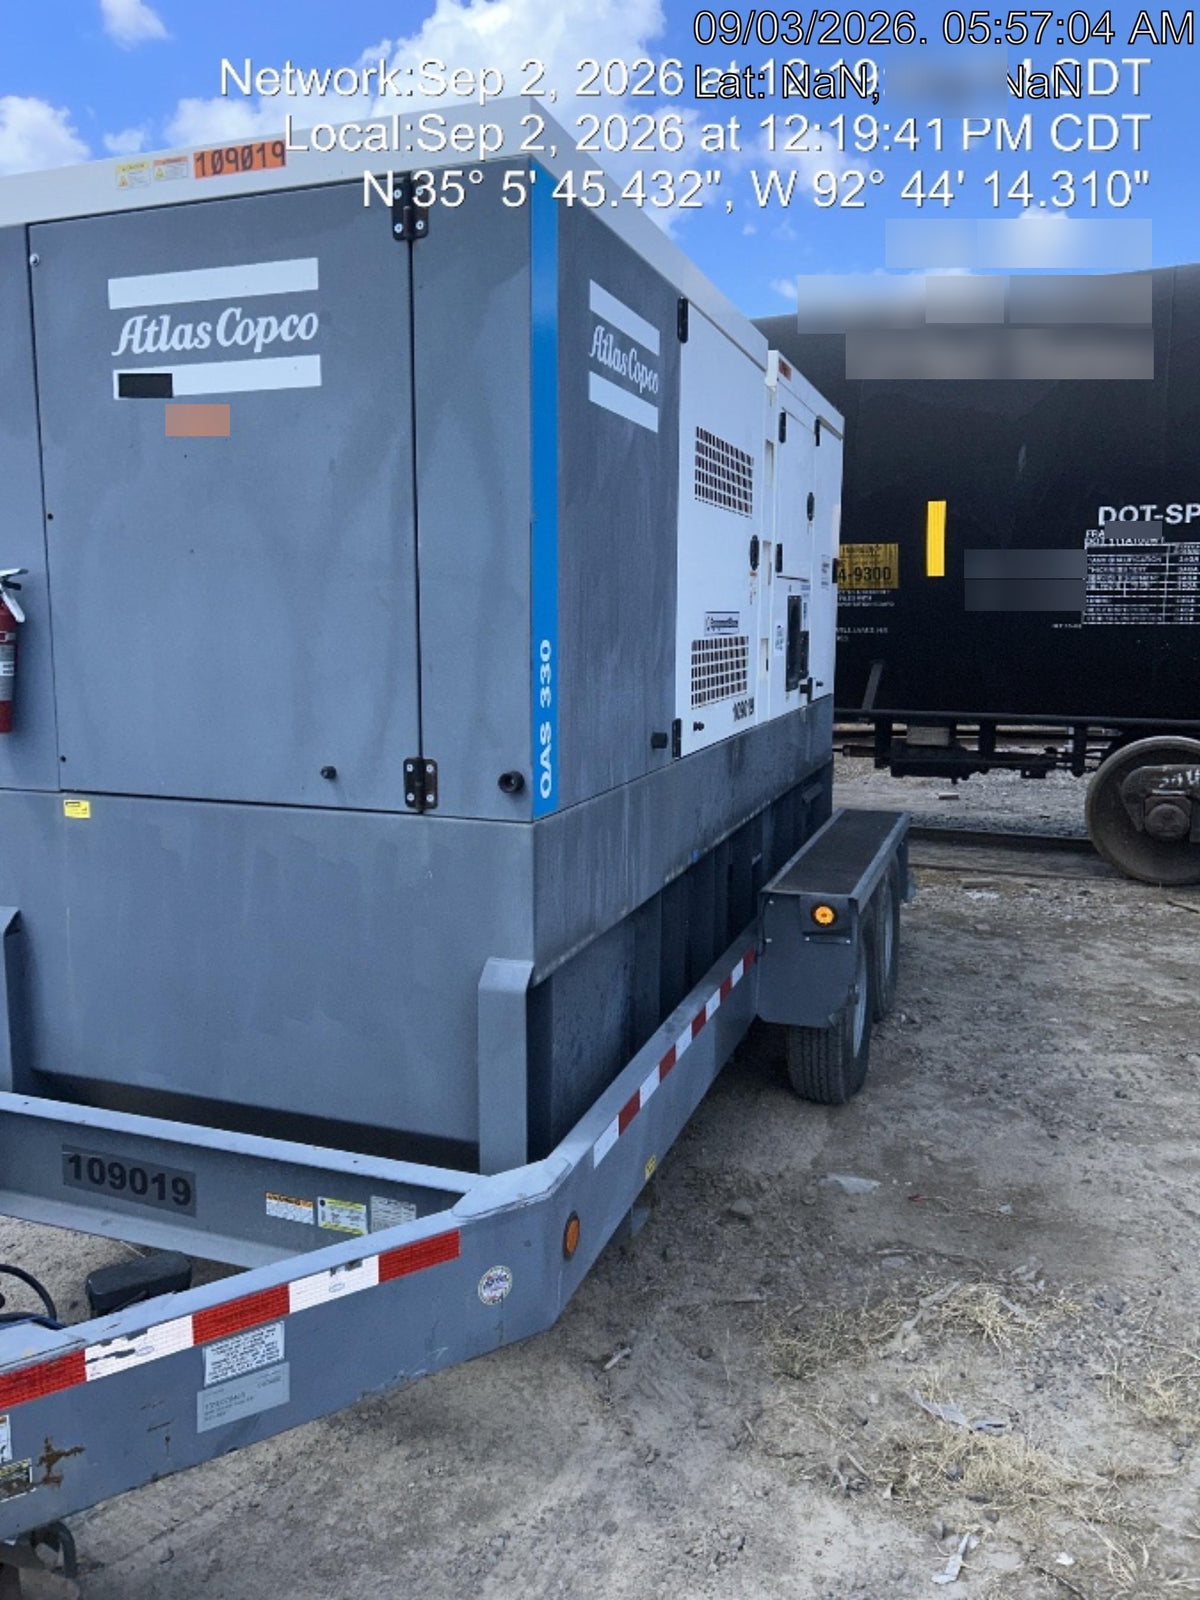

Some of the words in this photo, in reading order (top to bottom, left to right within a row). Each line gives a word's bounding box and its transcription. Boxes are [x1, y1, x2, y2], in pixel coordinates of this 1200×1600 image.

[194, 140, 287, 178] 109019
[111, 314, 212, 357] Atlas
[216, 306, 319, 354] Copco
[589, 325, 627, 377] Atlas
[628, 347, 659, 395] Copco
[539, 639, 552, 709] 330
[68, 1154, 192, 1207] 109019
